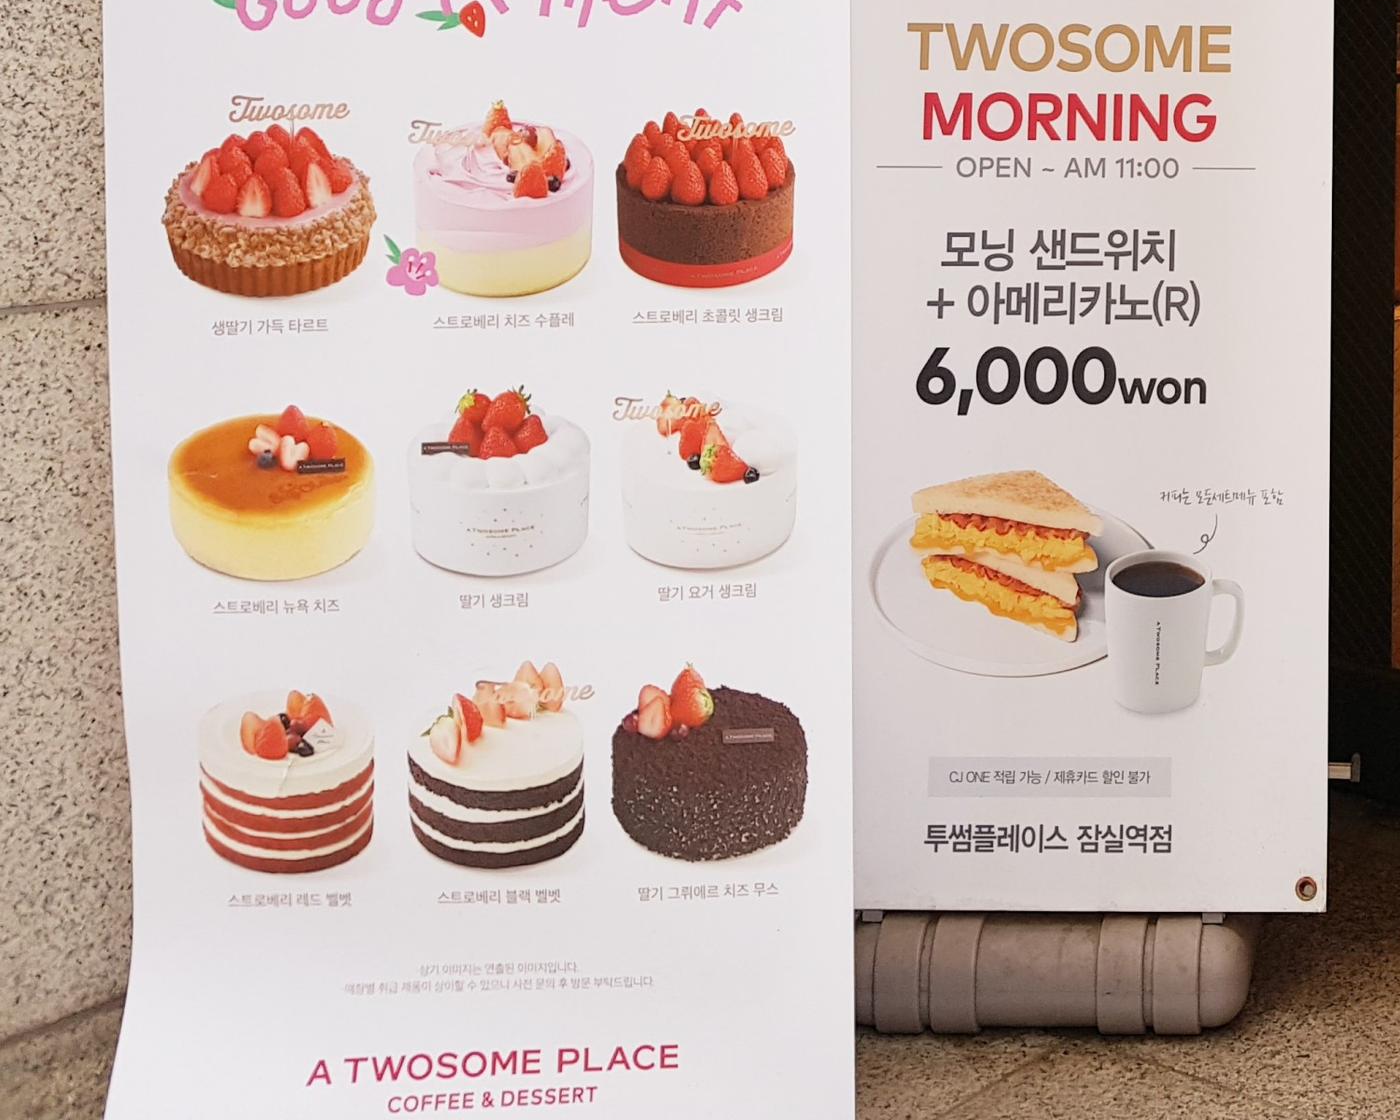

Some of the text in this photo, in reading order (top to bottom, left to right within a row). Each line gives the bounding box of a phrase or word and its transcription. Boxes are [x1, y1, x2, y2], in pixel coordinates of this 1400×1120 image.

[906, 22, 1232, 73] TWOSOME
[228, 94, 351, 124] Twosome
[922, 92, 1217, 143] MORNING
[676, 114, 797, 142] Twosome
[956, 156, 1032, 178] OPEN
[1063, 157, 1106, 179] AM
[1115, 157, 1180, 179] 11:00
[940, 228, 1176, 272] 모닝 샌드위치
[926, 280, 1201, 327] + 아메리카노(R)
[432, 311, 575, 330] 스트로베리 치즈 수플레
[632, 307, 784, 324] 스트로베리 초콜릿 생크림
[211, 317, 329, 337] 생딸기 가득 타르트
[459, 592, 529, 609] 딸기 생크림
[657, 583, 757, 601] 딸기 요거 생크림
[213, 598, 340, 615] 스트로베리 뉴욕 치즈
[949, 769, 1151, 785] CJ ONE 적립 가능 / 제휴카드 할인 불가
[923, 823, 1173, 854] 투썸플레이스 잠실역점
[228, 893, 292, 907] 스트로베리
[296, 892, 321, 906] 레드
[437, 889, 561, 904] 스트로베리 블랙 벨벳
[638, 886, 663, 902] 딸기
[724, 883, 750, 899] 치즈
[753, 882, 779, 897] 무스
[306, 1044, 680, 1087] A TWOSOME PLACE
[387, 1085, 598, 1114] COFFEE & DESSERT
